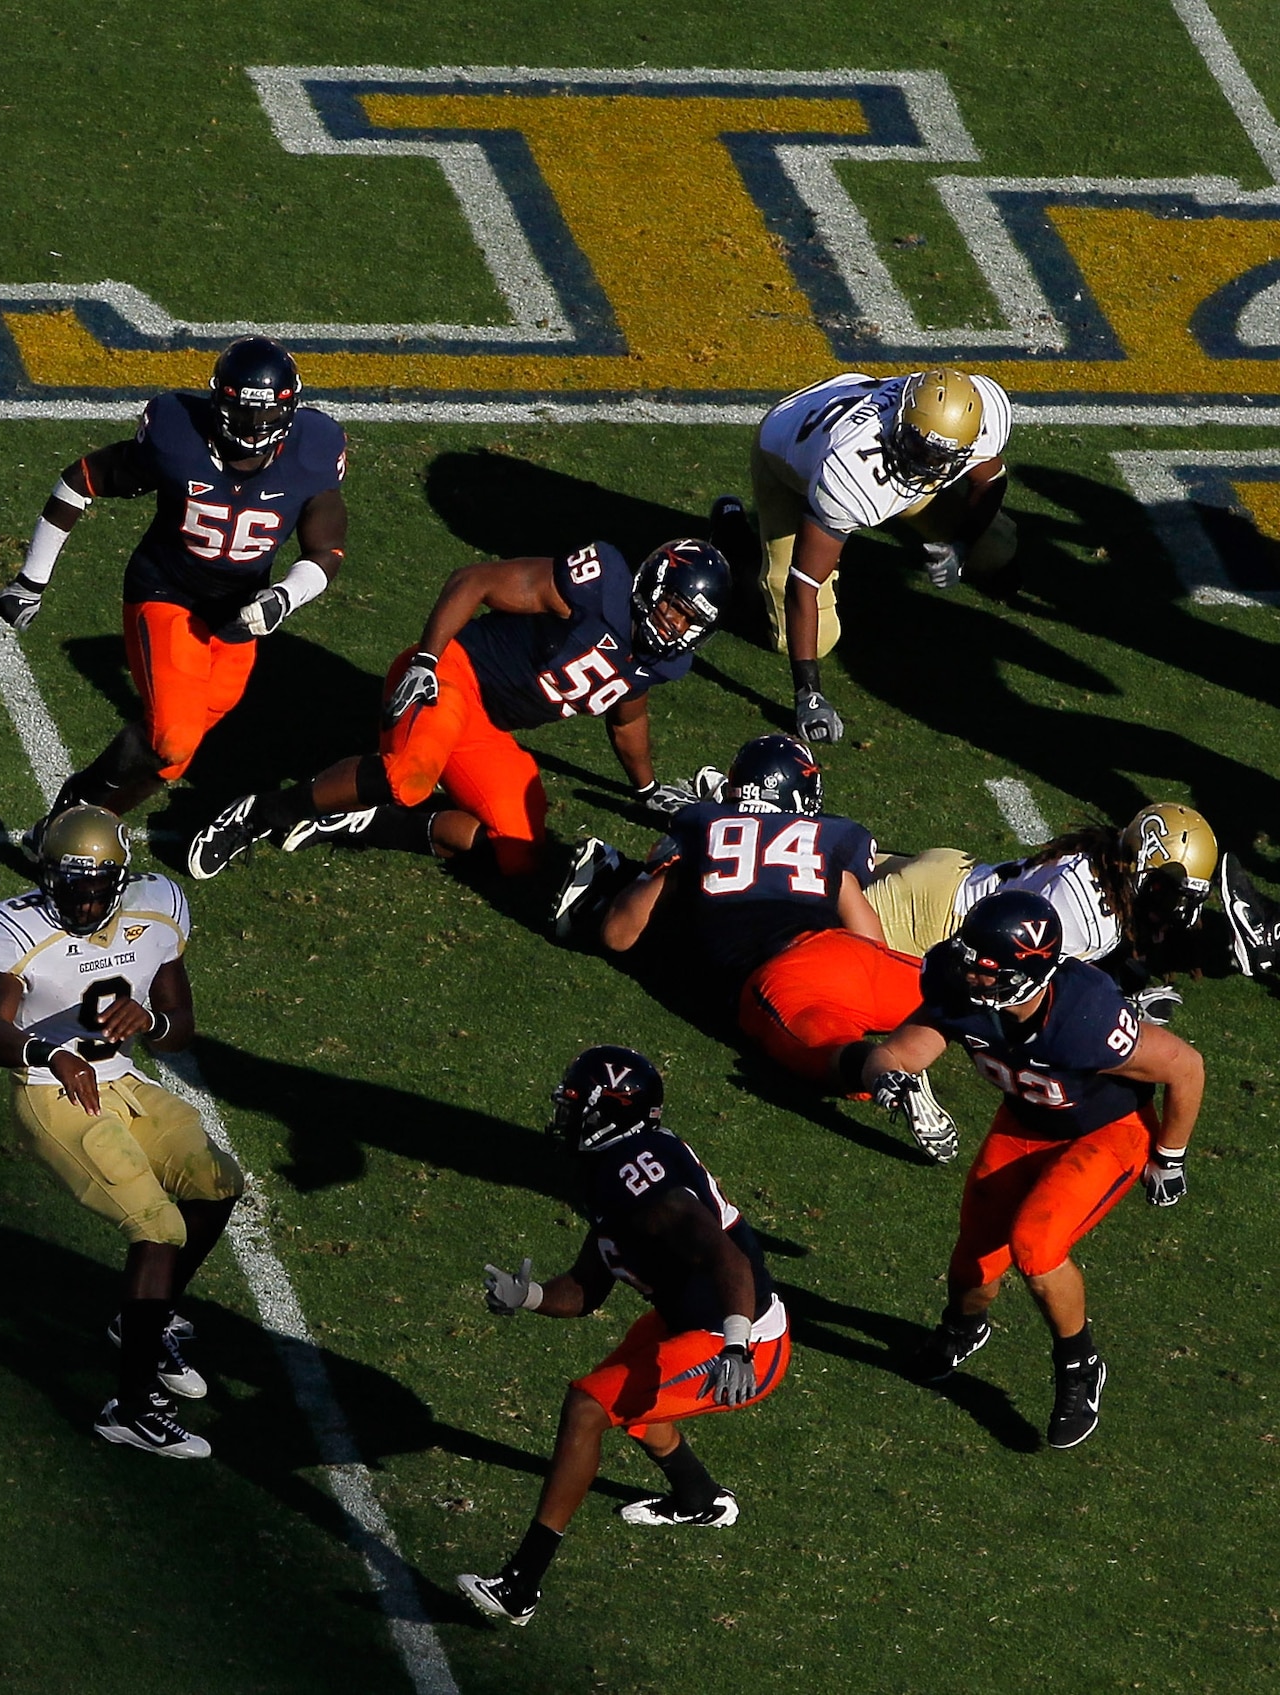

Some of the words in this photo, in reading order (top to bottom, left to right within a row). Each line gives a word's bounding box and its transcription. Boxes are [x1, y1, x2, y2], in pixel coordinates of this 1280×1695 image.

[180, 499, 283, 563] 56
[566, 543, 602, 585] 59
[537, 646, 633, 718] 59
[742, 783, 760, 800] 94
[700, 816, 828, 896] 94
[1021, 920, 1049, 948] V
[79, 956, 112, 974] GEORGIA
[113, 951, 136, 967] TECH
[1106, 1008, 1138, 1057] 92
[605, 1062, 633, 1089] V
[618, 1151, 666, 1197] 26
